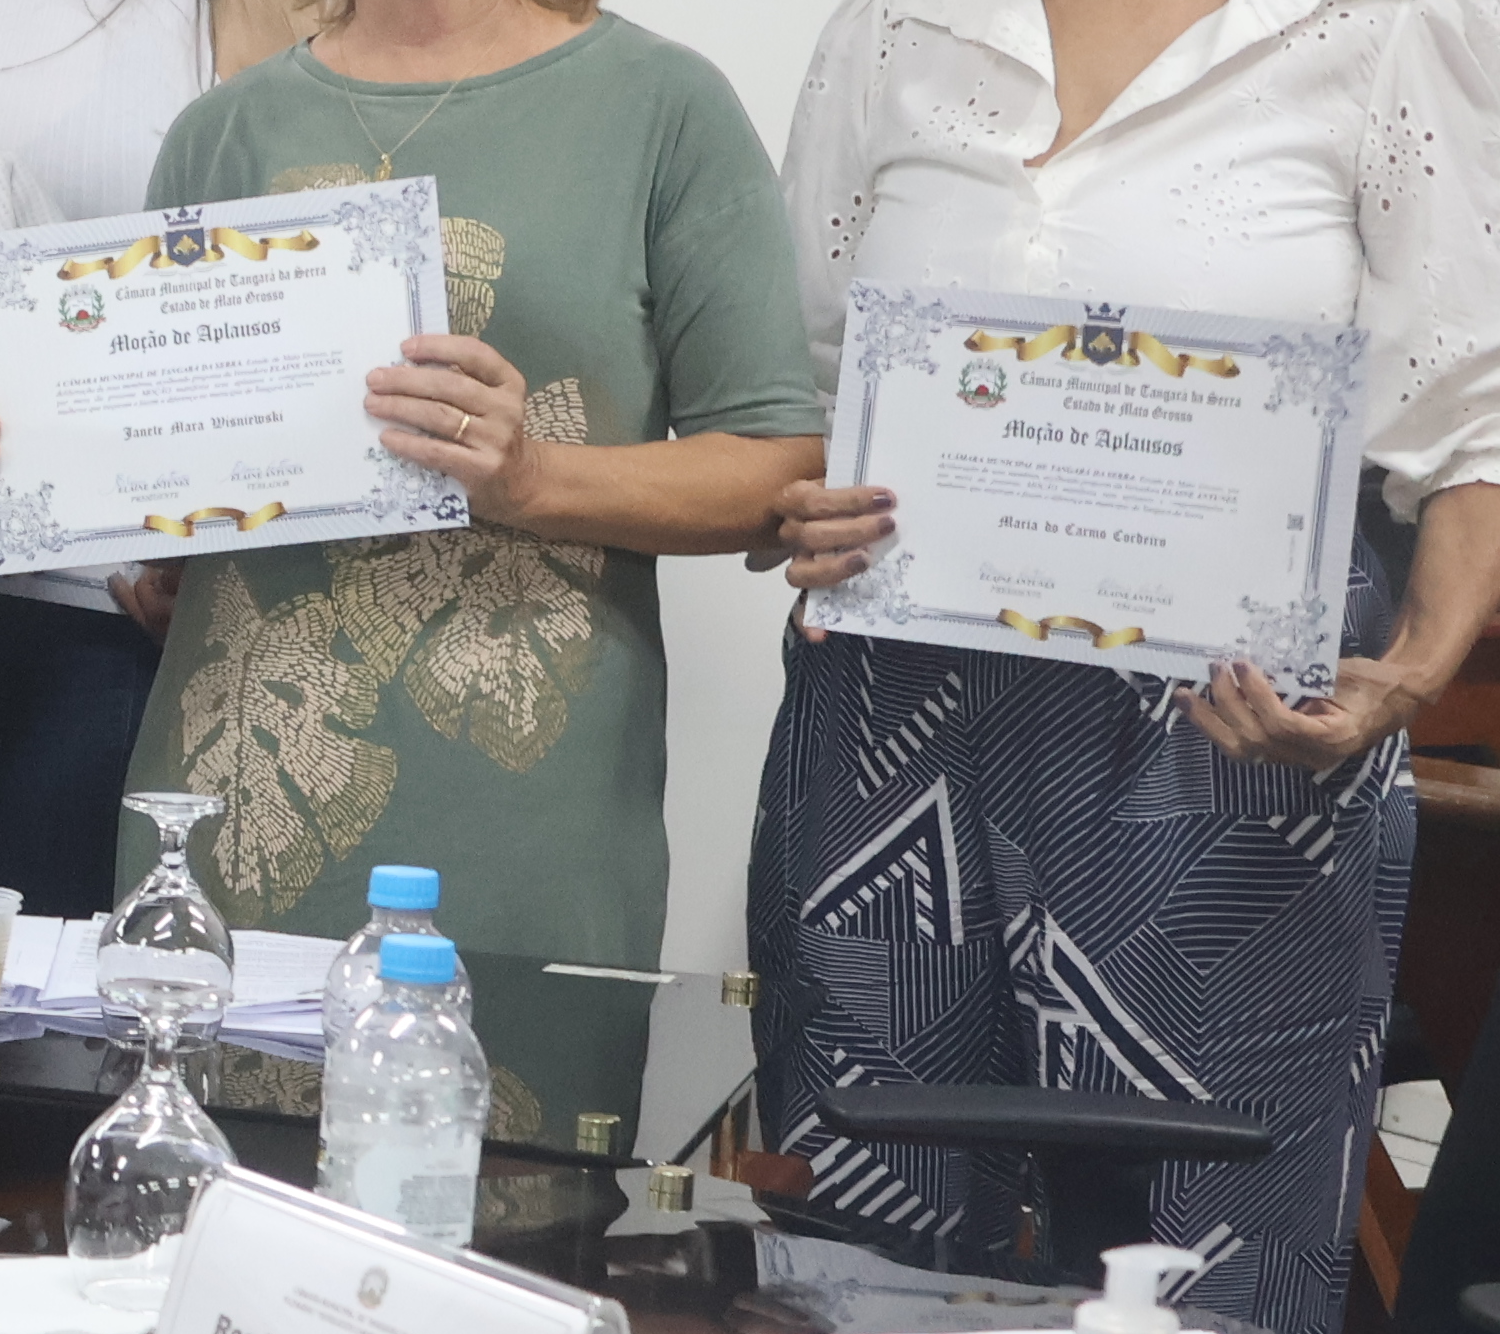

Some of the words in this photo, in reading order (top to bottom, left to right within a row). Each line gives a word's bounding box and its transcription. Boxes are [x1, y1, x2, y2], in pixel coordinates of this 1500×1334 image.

[109, 331, 168, 356] Moção
[172, 328, 192, 346] de
[196, 319, 282, 344] Aplausos
[123, 425, 164, 441] Janete
[170, 421, 205, 437] Mara
[210, 411, 284, 430] Wisniewski
[1003, 419, 1064, 444] Moção
[1070, 426, 1090, 446] de
[1095, 429, 1184, 458] Aplausos
